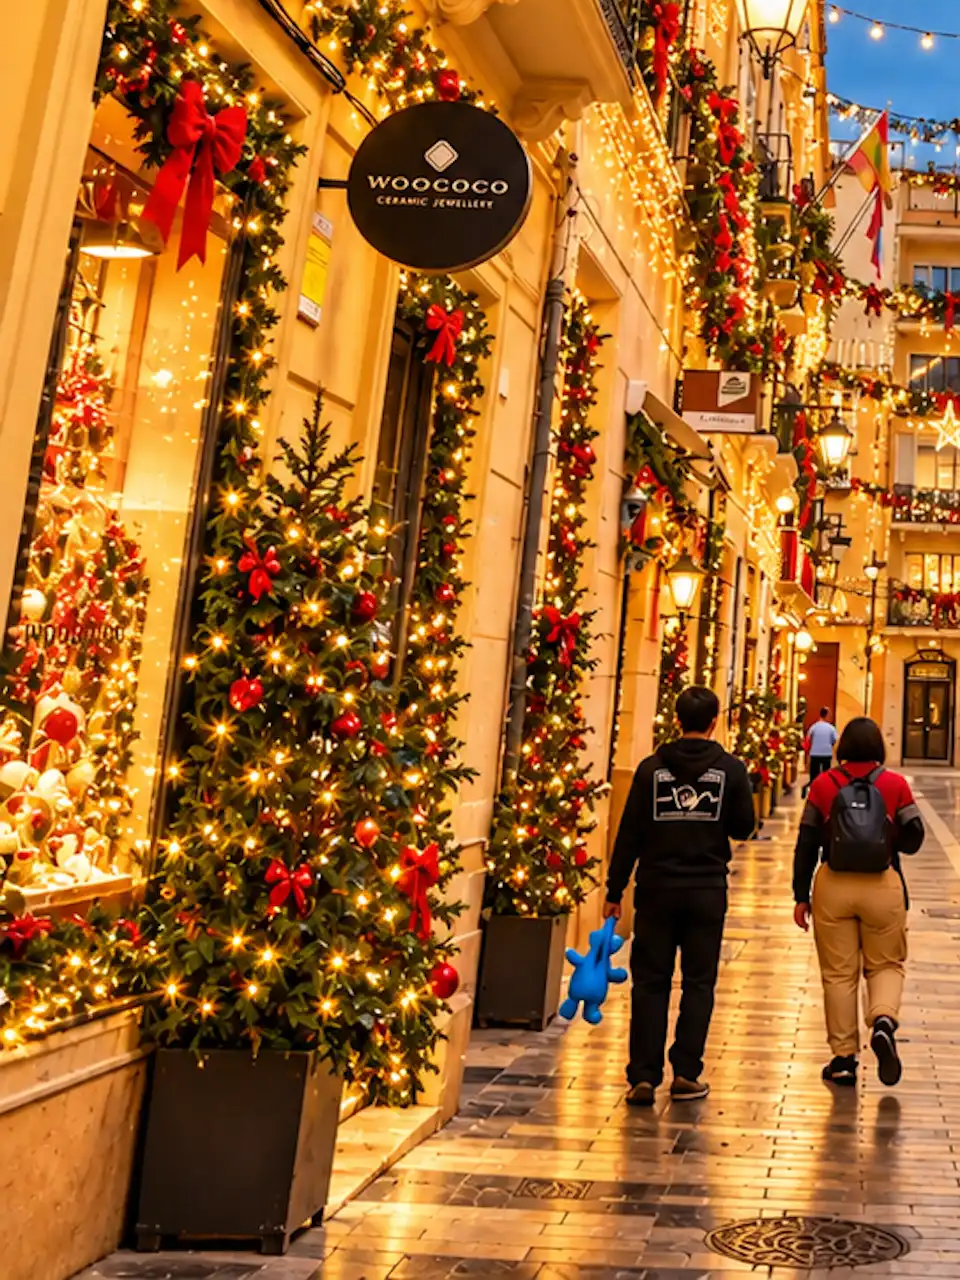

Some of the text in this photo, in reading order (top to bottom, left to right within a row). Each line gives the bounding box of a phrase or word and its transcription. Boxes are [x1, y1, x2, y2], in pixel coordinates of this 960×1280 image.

[367, 175, 509, 194] WOOCOCO
[376, 195, 494, 209] CERAMIC JEWELLERY
